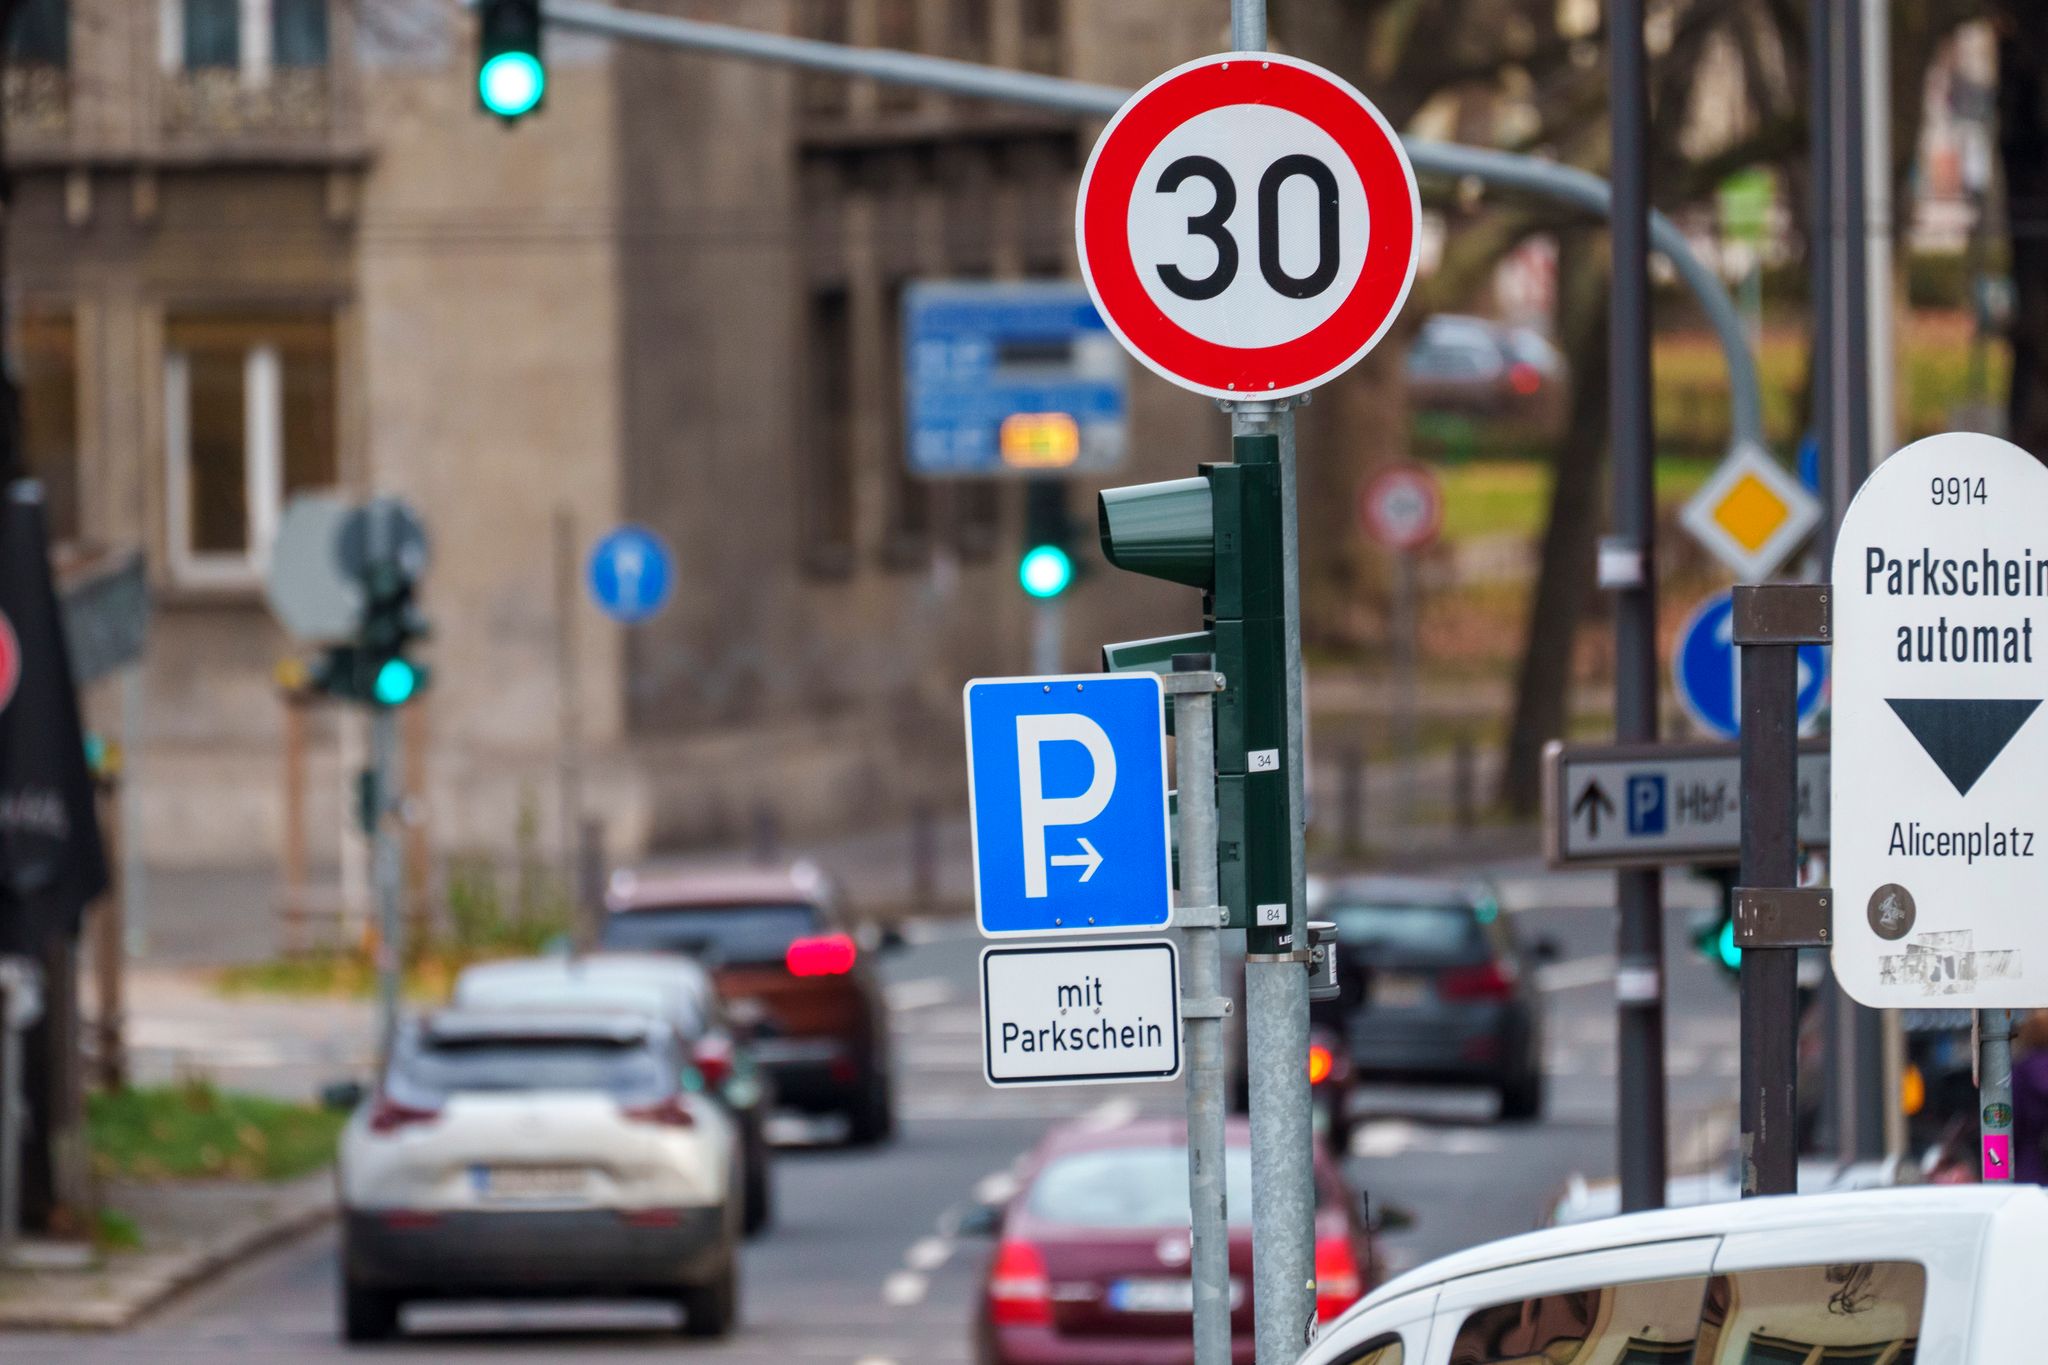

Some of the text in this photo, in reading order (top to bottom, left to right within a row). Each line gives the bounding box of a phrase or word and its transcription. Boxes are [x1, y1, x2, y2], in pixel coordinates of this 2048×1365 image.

[1155, 154, 1340, 301] 30
[1931, 477, 1988, 505] 9914
[1866, 547, 2048, 596] Parkschein
[1897, 617, 2032, 663] automat
[1257, 754, 1272, 767] 34
[1016, 713, 1117, 898] P
[1888, 822, 2034, 865] Alicenplatz
[1266, 909, 1281, 921] 84
[1058, 976, 1102, 1007] mit
[1002, 1017, 1162, 1054] Parkschein
